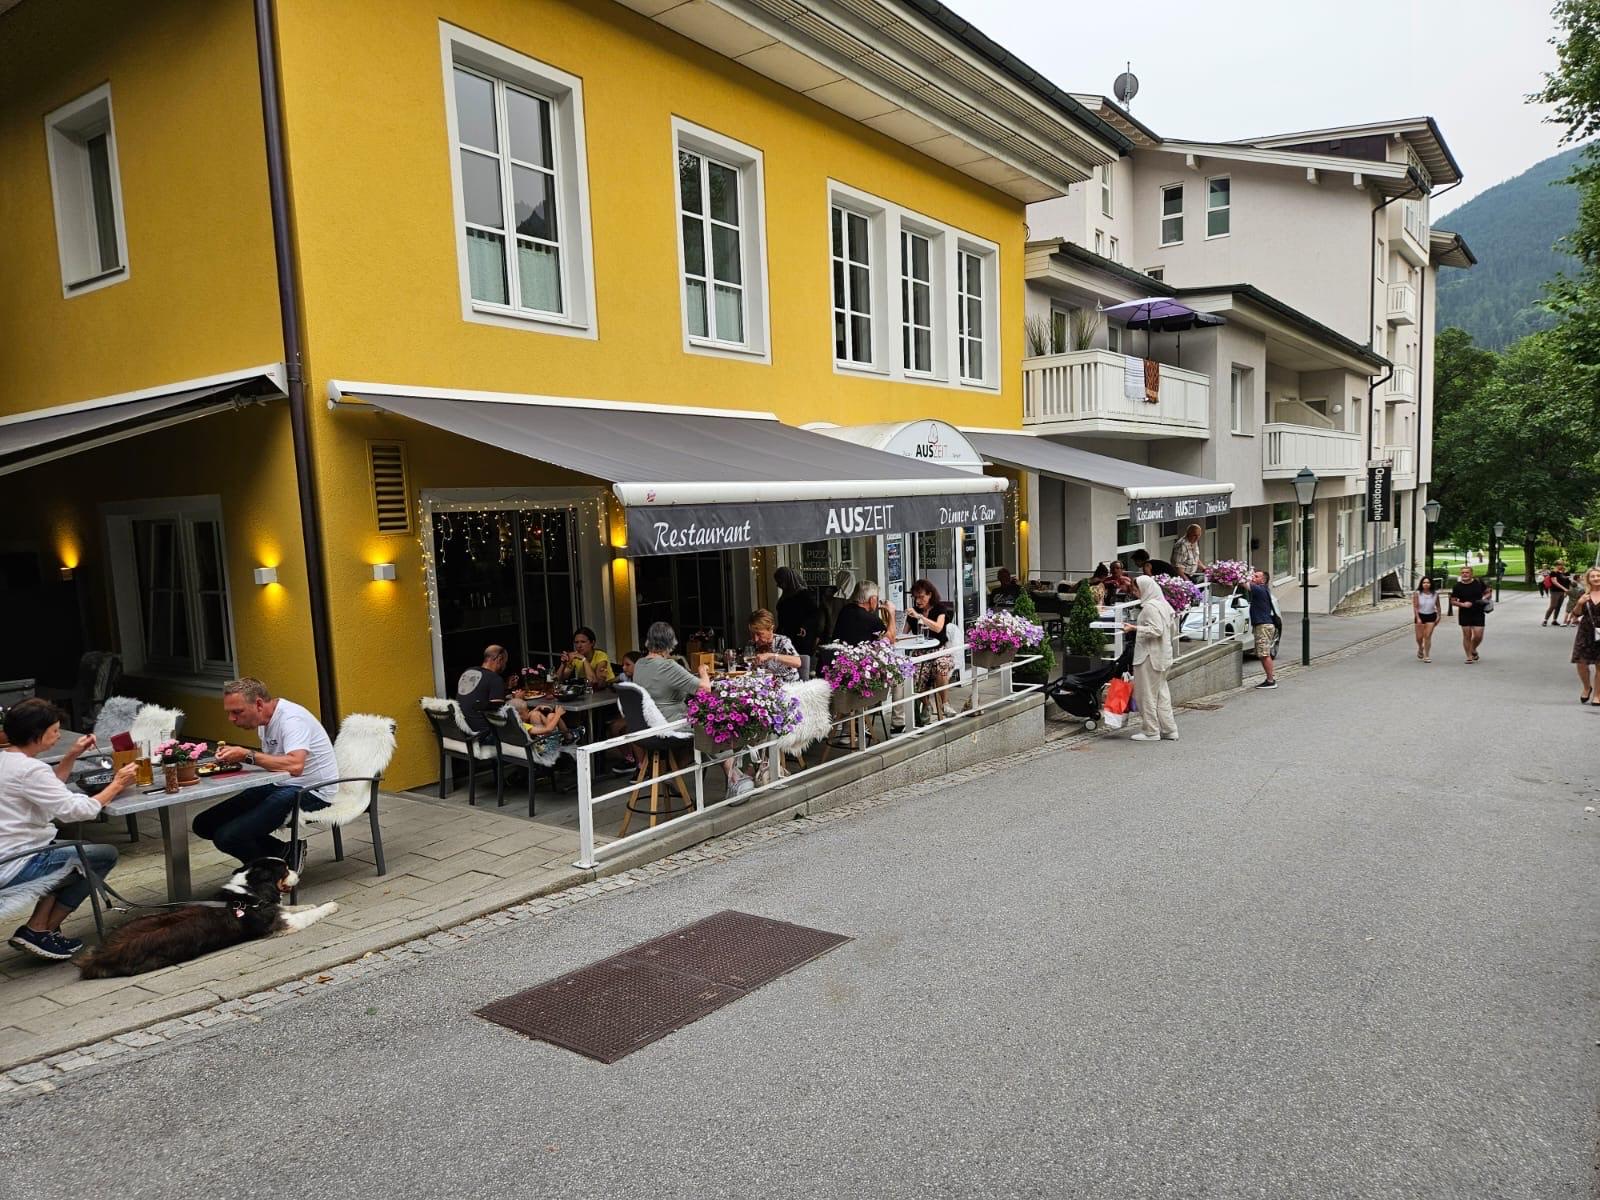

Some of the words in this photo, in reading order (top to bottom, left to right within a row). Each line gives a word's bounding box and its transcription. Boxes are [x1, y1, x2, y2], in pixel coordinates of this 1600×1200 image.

[654, 519, 751, 551] Restaurant
[826, 504, 894, 535] AUSZEIT
[939, 507, 970, 525] Dinner
[971, 505, 978, 521] &
[980, 504, 996, 521] Bar
